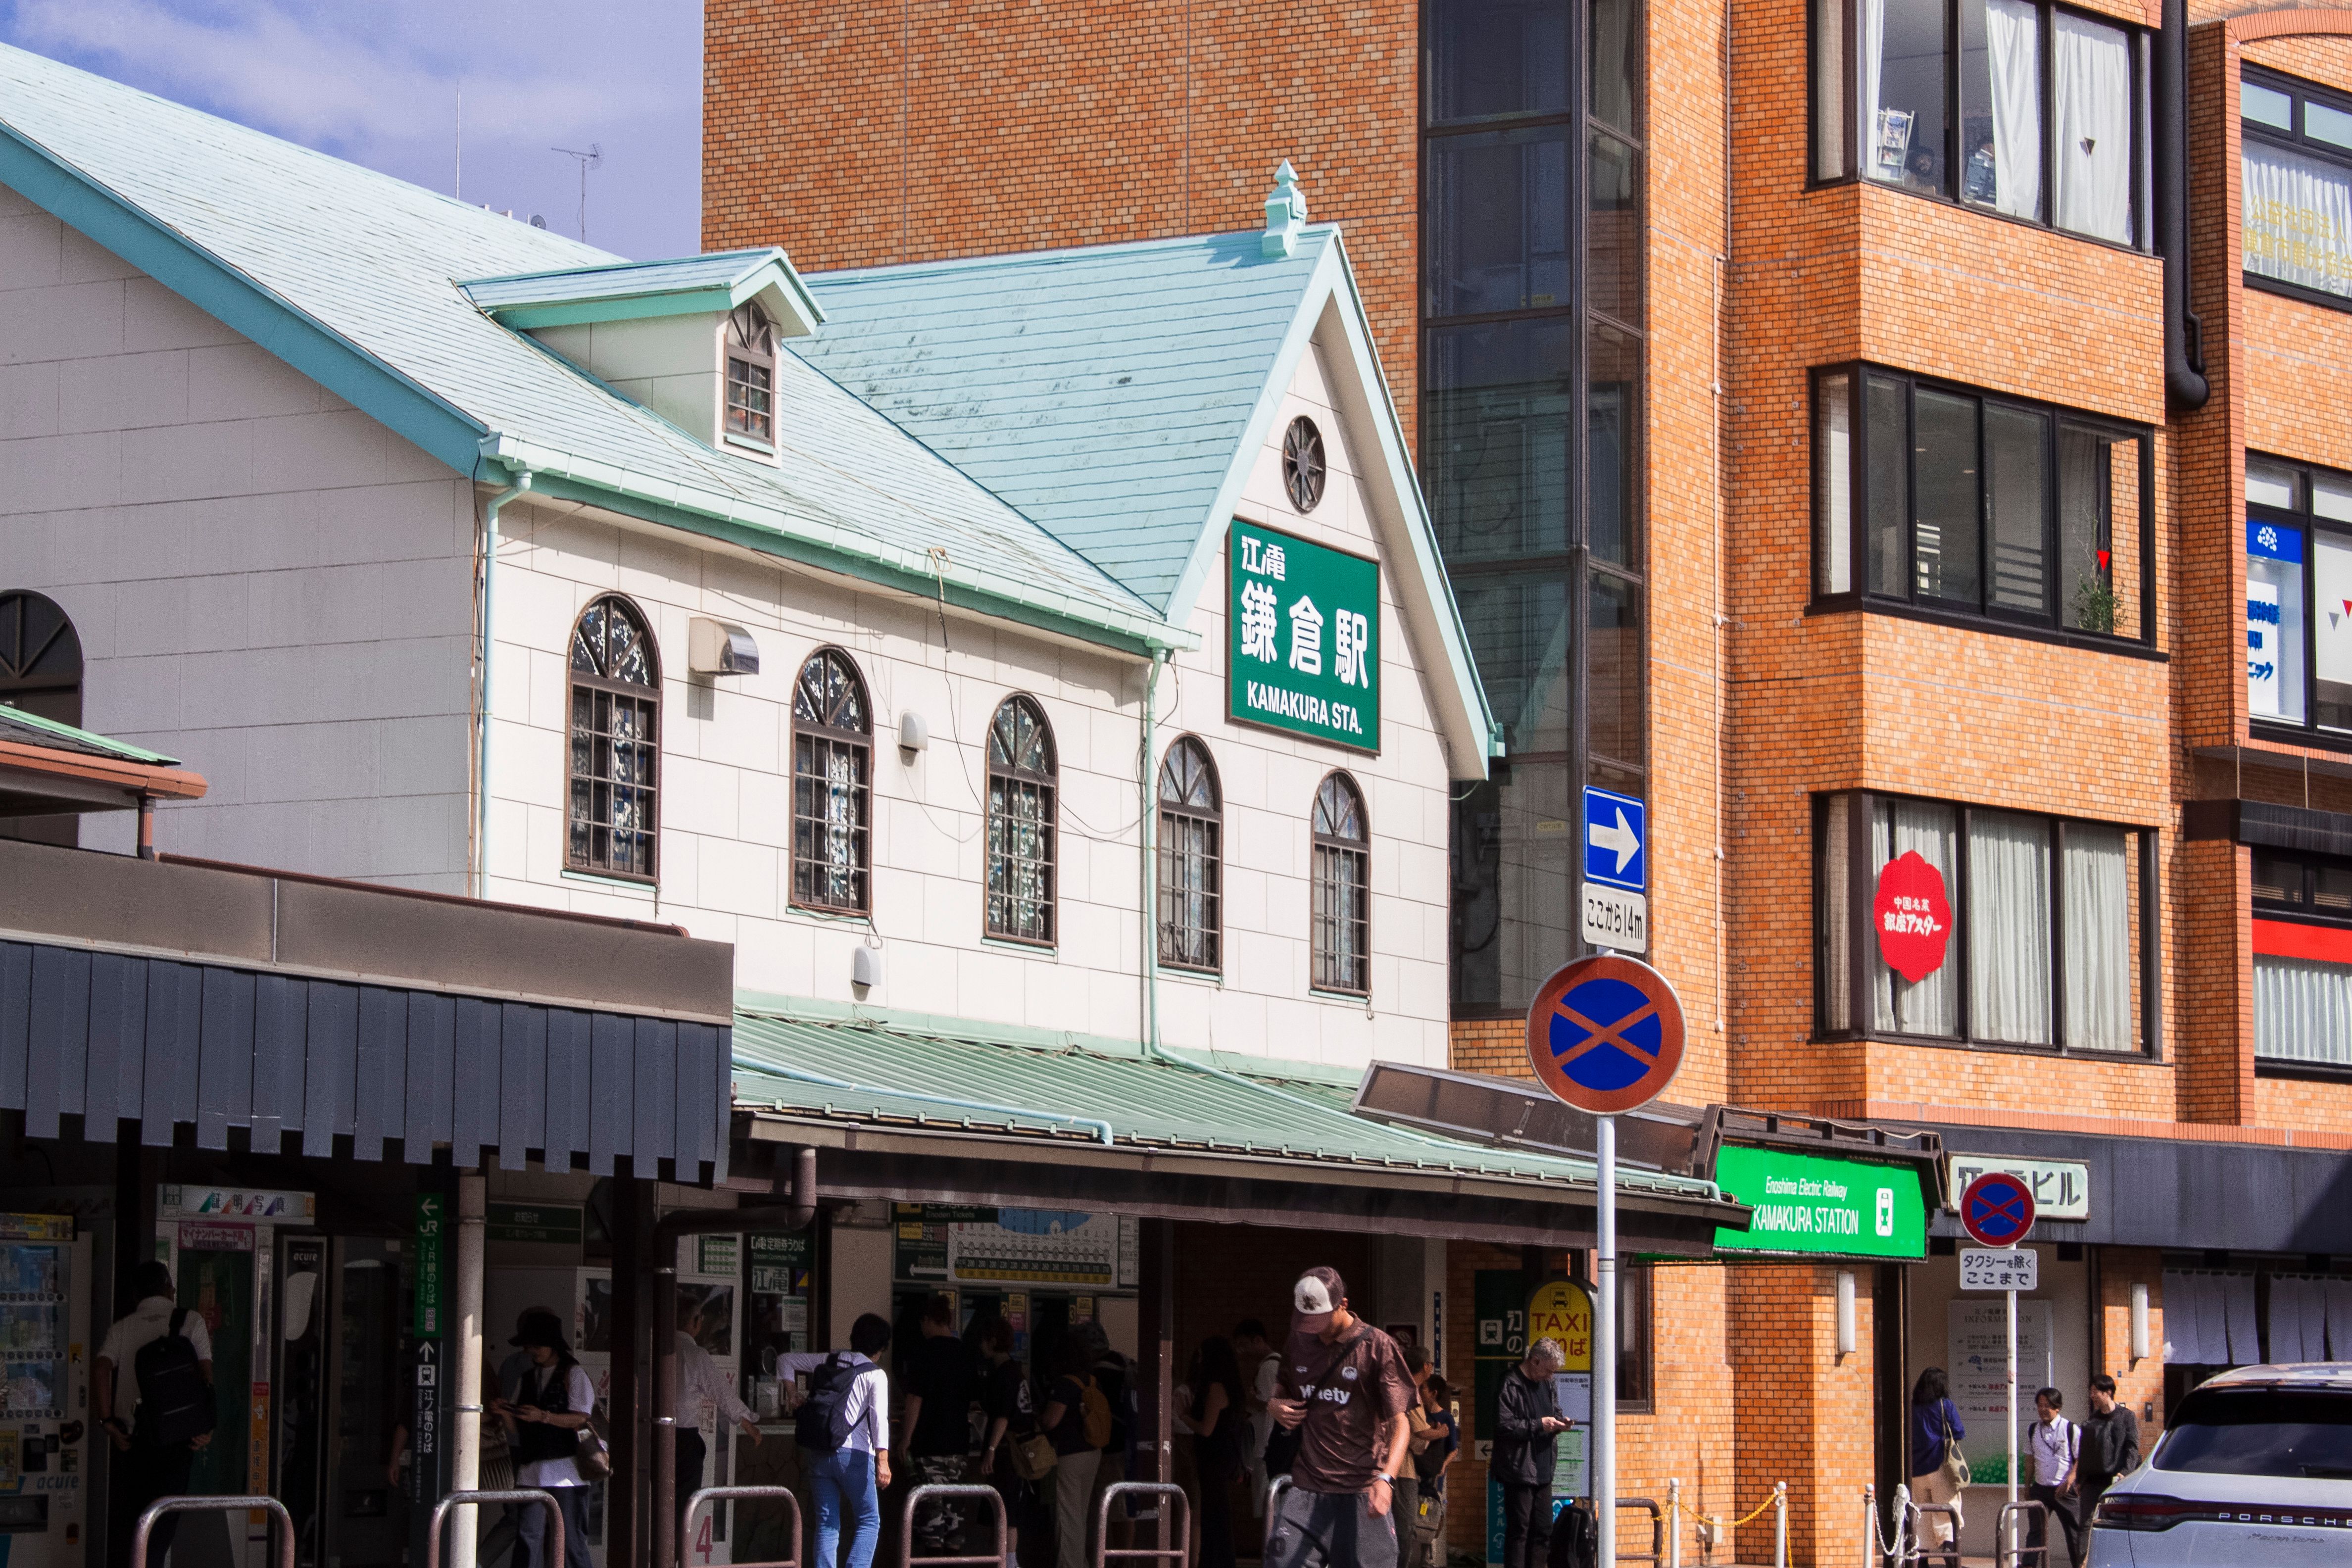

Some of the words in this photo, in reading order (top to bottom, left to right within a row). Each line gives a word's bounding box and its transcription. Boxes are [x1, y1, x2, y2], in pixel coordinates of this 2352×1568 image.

[2251, 195, 2347, 244] 公益社団法人
[1241, 579, 1369, 689] 鎌倉駅
[1247, 680, 1329, 726] KAMAKURA
[1332, 701, 1363, 735] STA.
[1884, 911, 1943, 937] 銀座アスター
[1765, 1176, 1797, 1195] Enoshima
[1798, 1177, 1822, 1196] Electric
[1822, 1179, 1848, 1202] Railway
[420, 1220, 438, 1233] JR
[1753, 1204, 1813, 1232] KAMAKURA
[1814, 1207, 1859, 1235] STATION
[294, 1252, 318, 1262] acure
[1963, 1255, 2032, 1269] タクシーを除く
[1966, 1272, 2029, 1285] ここまで
[1532, 1313, 1588, 1332] TAXI
[424, 1389, 434, 1454] 江ノ電のりば
[695, 1516, 713, 1564] 4
